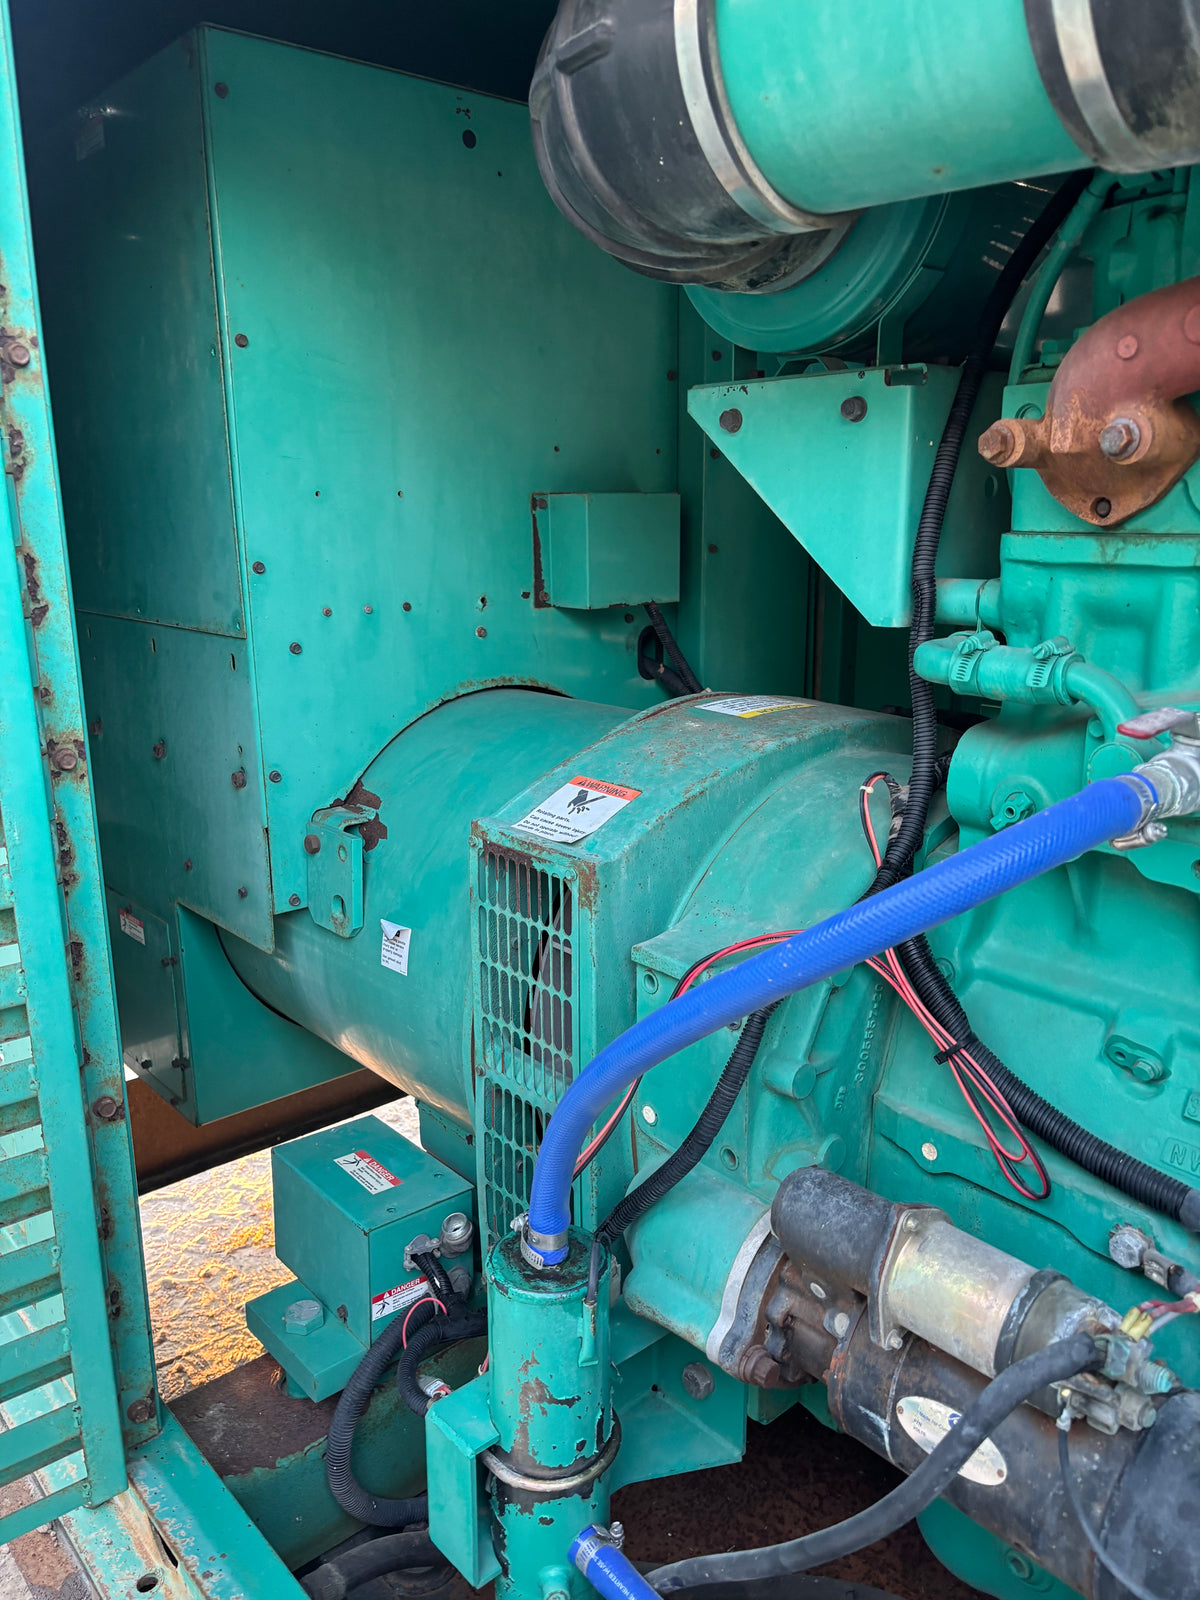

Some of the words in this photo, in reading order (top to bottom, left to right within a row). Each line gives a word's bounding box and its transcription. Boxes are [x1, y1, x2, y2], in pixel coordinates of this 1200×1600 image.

[586, 780, 628, 798] WARNING
[369, 1161, 394, 1181] DANGER
[390, 1278, 420, 1296] DANGER
